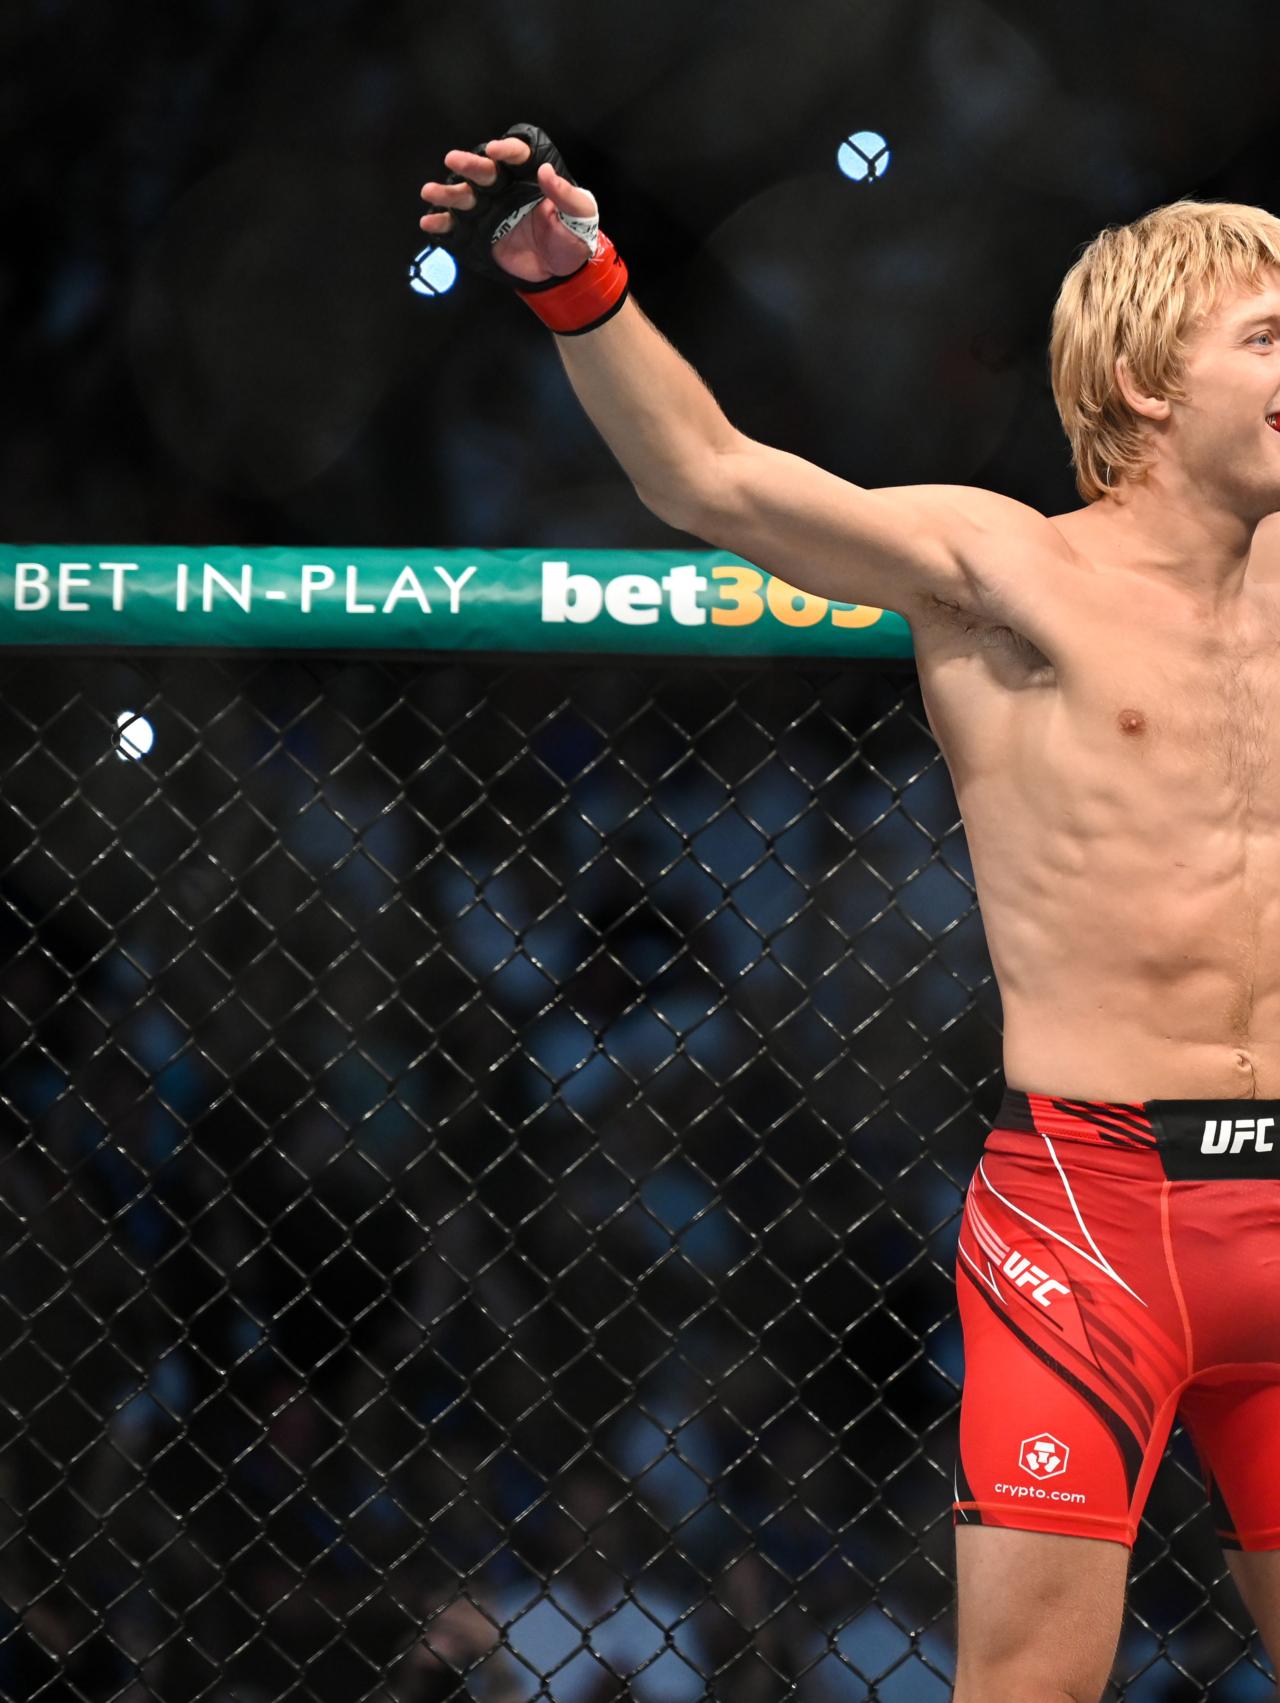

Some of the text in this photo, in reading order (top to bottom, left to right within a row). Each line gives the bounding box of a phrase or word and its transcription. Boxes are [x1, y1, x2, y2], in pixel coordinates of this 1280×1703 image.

[14, 562, 139, 613] BET
[176, 563, 478, 614] IN-PLAY
[1200, 1118, 1274, 1154] UFC
[1002, 1250, 1071, 1307] UFC
[994, 1483, 1086, 1504] crypto.com
